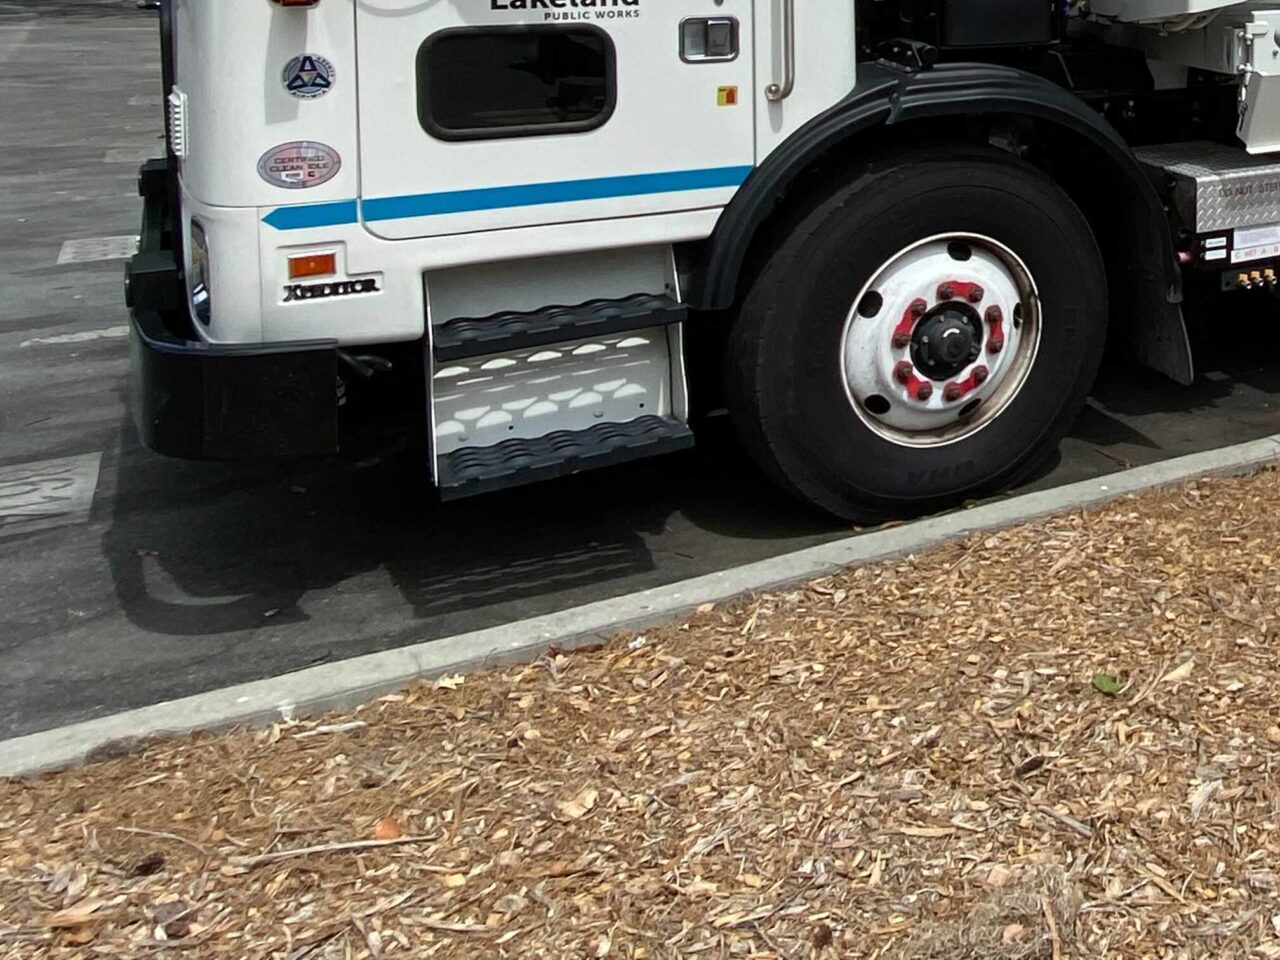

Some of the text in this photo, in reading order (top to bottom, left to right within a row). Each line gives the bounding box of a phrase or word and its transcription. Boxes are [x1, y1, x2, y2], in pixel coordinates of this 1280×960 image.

[544, 9, 640, 21] PUBLIC WORKS
[269, 165, 303, 173] CLEAN
